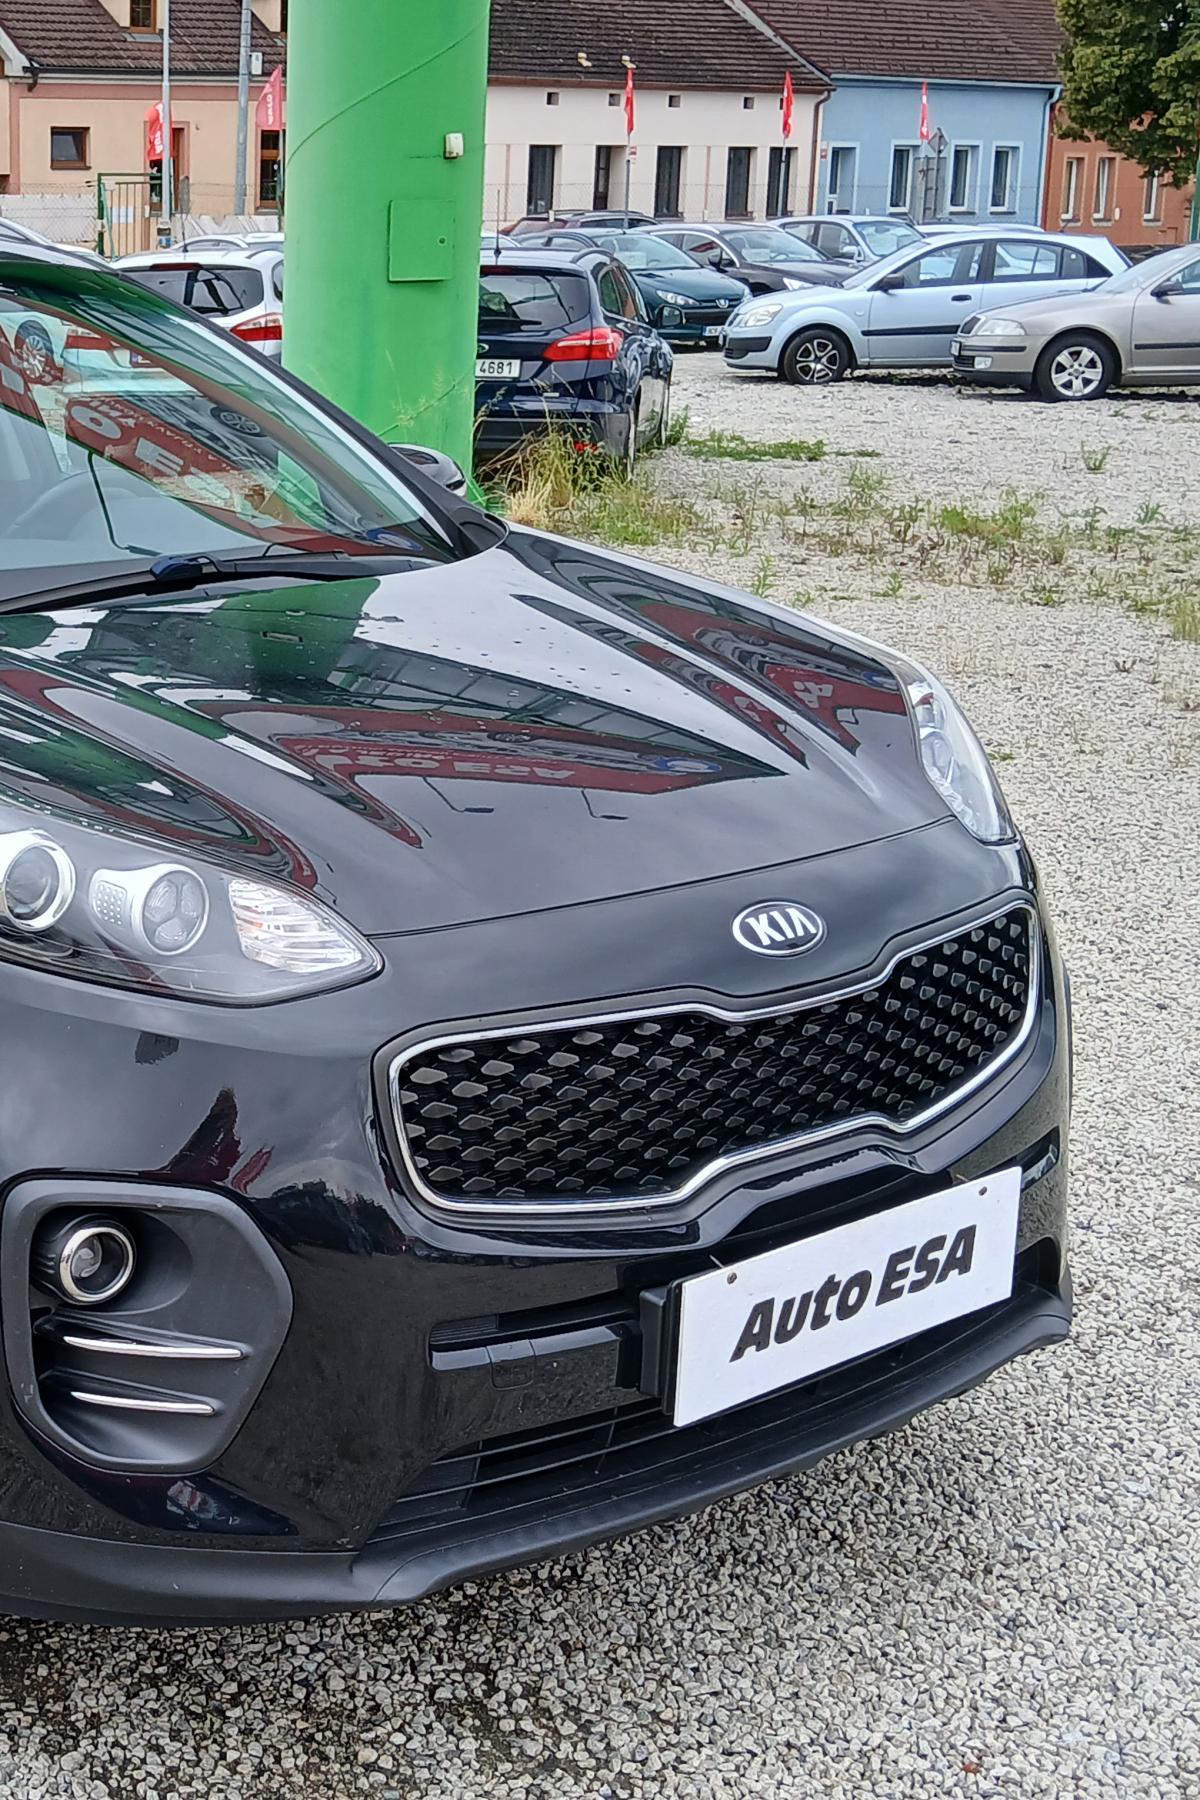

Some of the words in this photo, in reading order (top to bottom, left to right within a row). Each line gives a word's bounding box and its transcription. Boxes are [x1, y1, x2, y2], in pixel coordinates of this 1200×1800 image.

[479, 361, 512, 375] 4681
[744, 907, 817, 946] KIA
[729, 1269, 873, 1363] Auto
[875, 1224, 977, 1307] ESA
